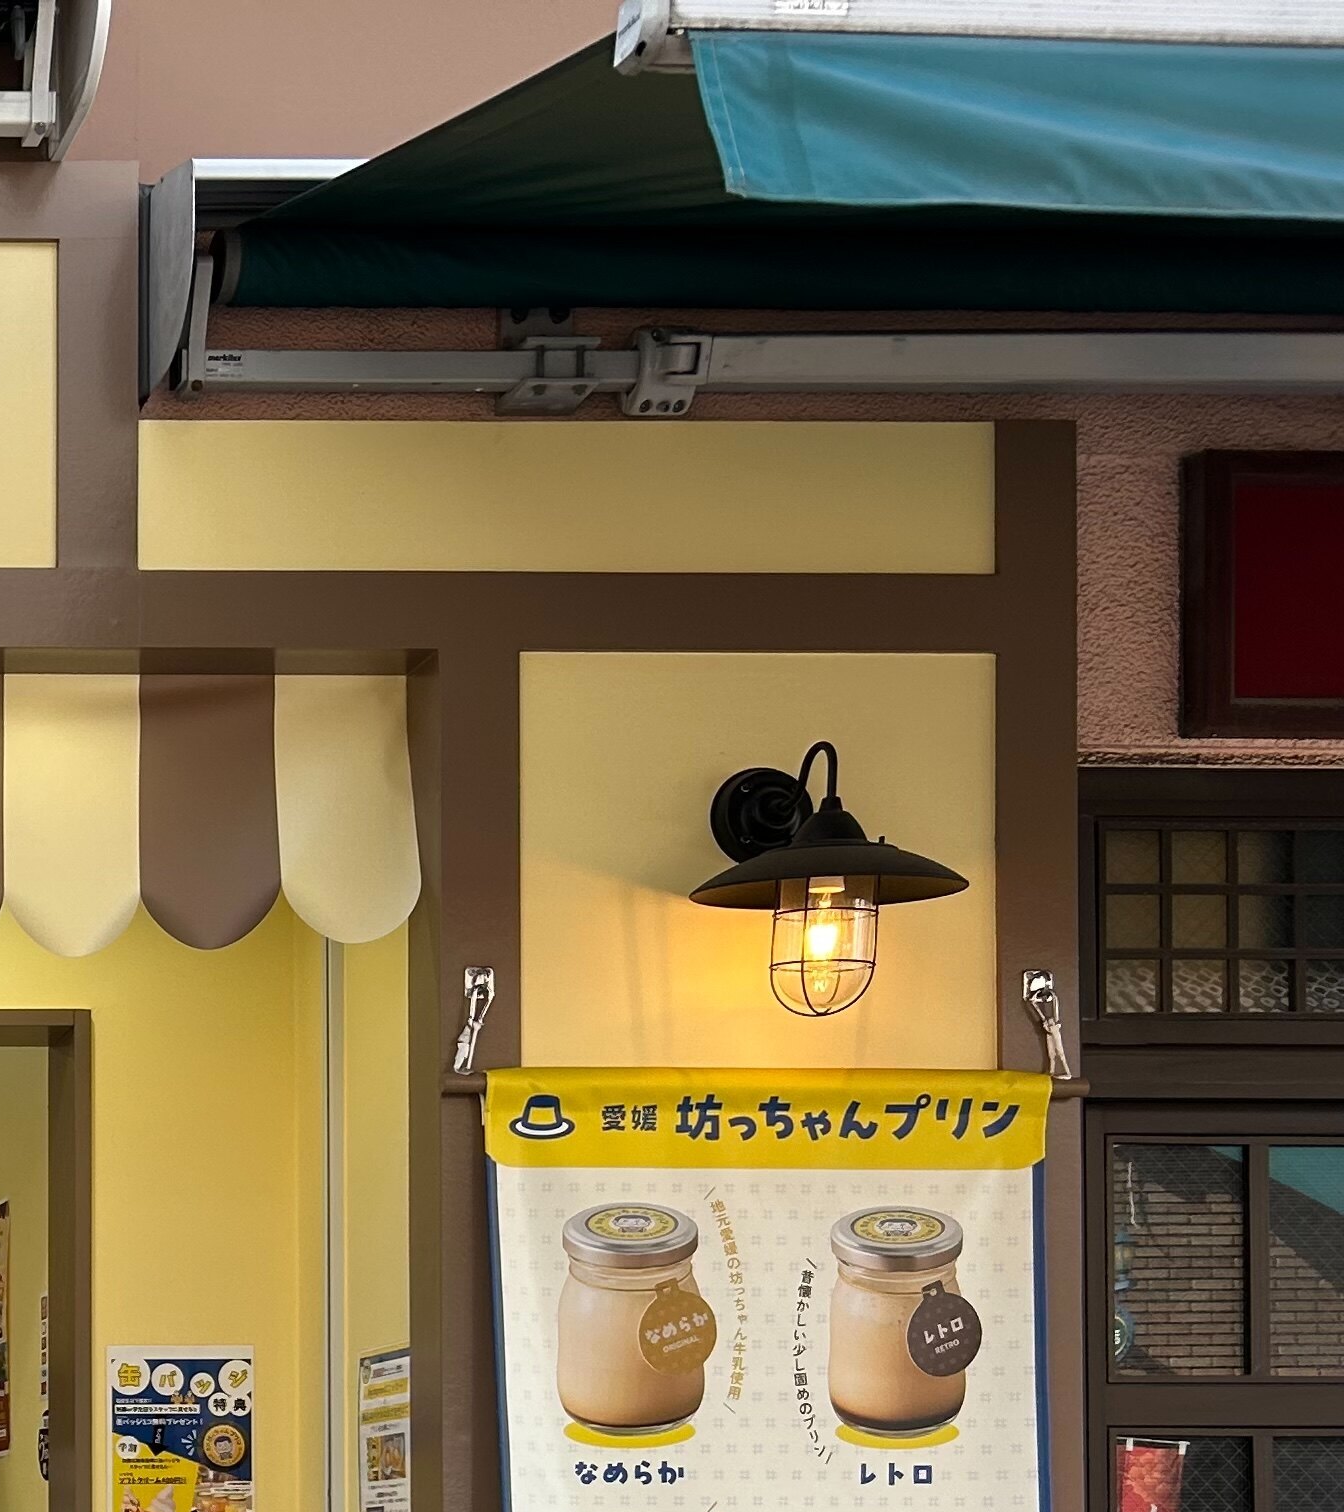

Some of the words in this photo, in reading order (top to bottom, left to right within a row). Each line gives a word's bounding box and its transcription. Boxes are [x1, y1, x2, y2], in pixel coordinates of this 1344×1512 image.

[601, 1104, 658, 1133] 愛媛
[674, 1094, 1021, 1141] 坊っちゃんプリン
[710, 1199, 748, 1401] 地元愛媛の坊っちゃん牛乳使用
[645, 1312, 709, 1344] なめらか
[923, 1317, 963, 1345] レトロ
[663, 1335, 701, 1353] ORIGINAL
[934, 1339, 960, 1354] RETRO
[792, 1269, 826, 1457] 昔懐かしい少し固めのプリン
[213, 1398, 247, 1412] 特典
[574, 1460, 685, 1485] なめらか
[860, 1462, 932, 1486] レトロ
